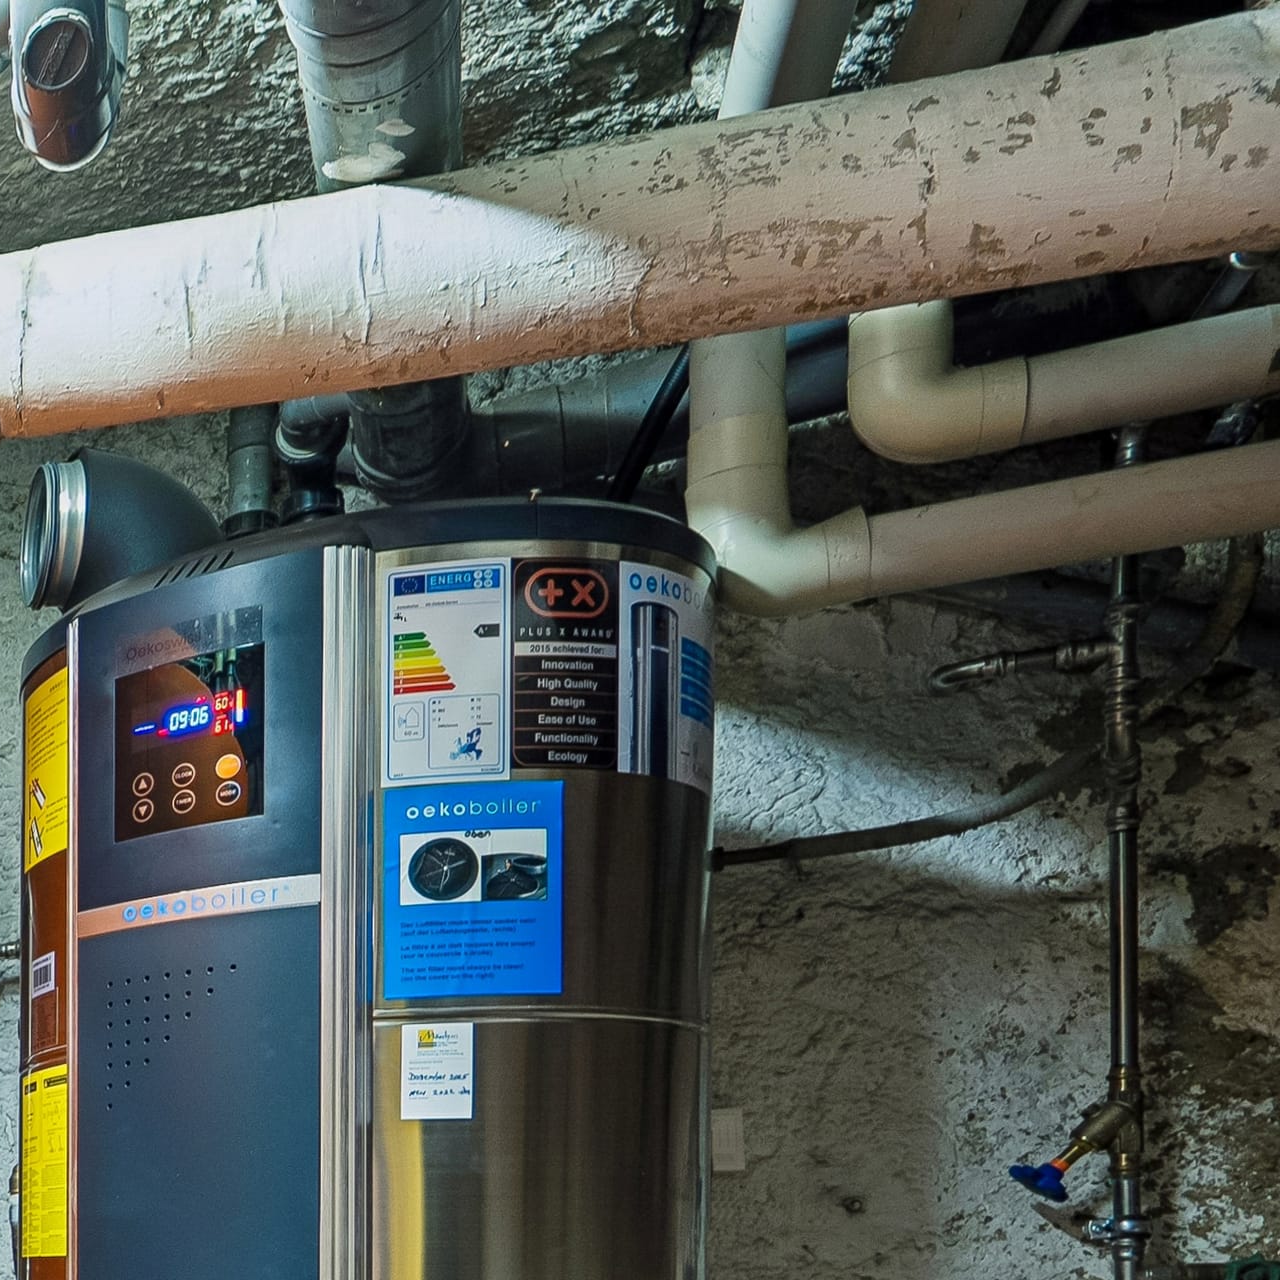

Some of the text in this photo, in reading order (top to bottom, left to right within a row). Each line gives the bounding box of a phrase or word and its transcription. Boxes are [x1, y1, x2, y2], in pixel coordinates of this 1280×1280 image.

[628, 572, 712, 612] oekobo
[519, 627, 612, 639] PLUS X AWARD
[529, 643, 551, 654] 2015
[552, 643, 589, 654] achieved
[541, 658, 594, 671] Innovation
[537, 677, 598, 692] High Quality
[214, 696, 229, 711] 60
[550, 696, 586, 711] Design
[168, 705, 209, 732] 09:06
[537, 714, 597, 726] Ease of Use
[534, 732, 599, 747] Functionality
[547, 750, 588, 764] Ecology
[406, 799, 538, 820] oekoboiler
[464, 829, 491, 839] oben
[122, 887, 280, 923] oekoboiler
